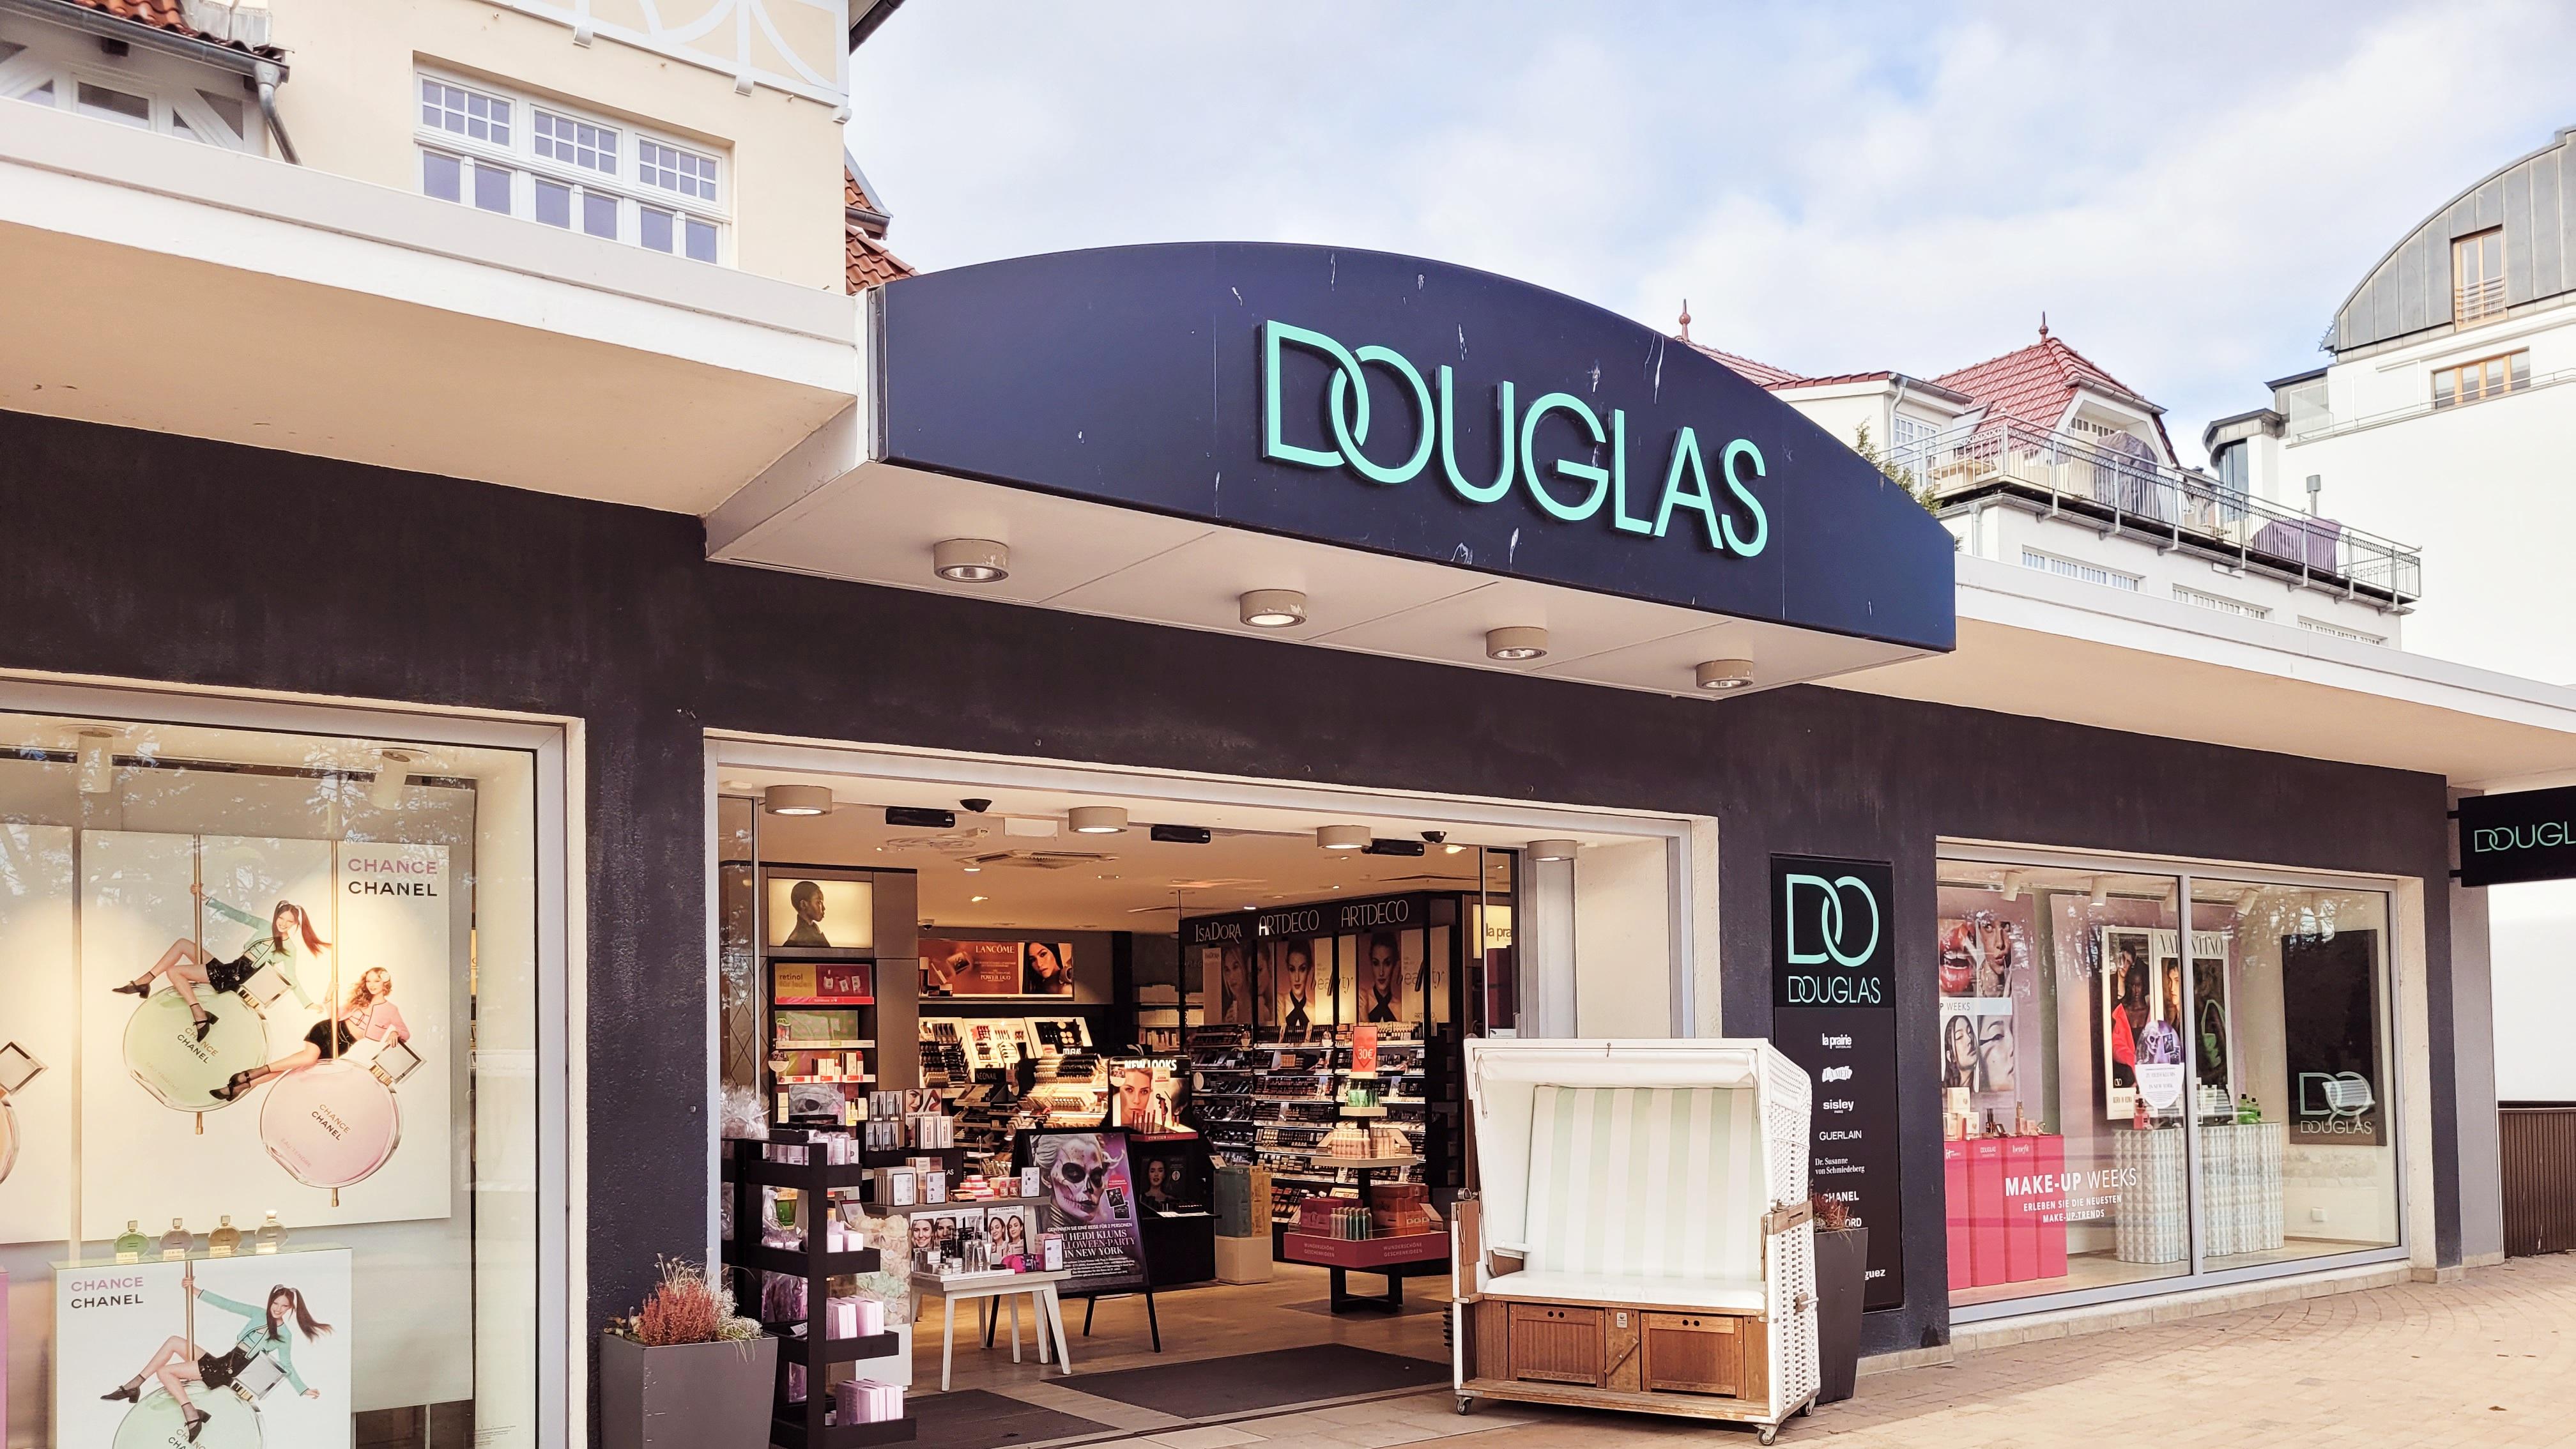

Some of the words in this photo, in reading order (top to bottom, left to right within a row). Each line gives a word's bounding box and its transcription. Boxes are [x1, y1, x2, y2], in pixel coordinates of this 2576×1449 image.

[1263, 319, 1768, 558] DOUGLAS
[2474, 821, 2576, 852] DOUGL
[348, 859, 438, 875] CHANCE
[348, 881, 438, 897] CHANEL
[1342, 900, 1408, 928] ARTDECO
[1786, 873, 1879, 967] DO
[1259, 910, 1319, 936] ARTDECO
[1485, 923, 1495, 937] la
[976, 944, 1015, 954] LANCÔME
[2159, 934, 2223, 956] VALNTINO
[1788, 976, 1881, 1004] DOUGLAS
[1946, 1002, 1971, 1011] WEEKS
[185, 1027, 218, 1057] CHNCE
[1821, 1032, 1829, 1046] la
[1829, 1034, 1852, 1049] prairie
[177, 1034, 209, 1064] CHANEL
[1358, 1048, 1374, 1059] 30€
[1124, 1060, 1146, 1069] NEW
[1823, 1099, 1854, 1112] sisley
[311, 1111, 341, 1141] CHANEL
[319, 1104, 351, 1133] CHANCE
[2301, 1120, 2372, 1134] DOUGLAS
[1819, 1130, 1862, 1141] GUERLAIN
[1815, 1158, 1824, 1166] Dr.
[1825, 1157, 1848, 1165] Susanne
[1826, 1165, 1865, 1174] Schmiedeberg
[2005, 1172, 2082, 1197] MAKE-UP
[2087, 1167, 2137, 1190] WEEKS
[2023, 1200, 2056, 1212] ERLEBEN
[2058, 1199, 2069, 1209] SIE
[2072, 1198, 2084, 1208] DIE
[2086, 1194, 2122, 1206] NEUESTEN
[1845, 1217, 1862, 1227] ORD
[2043, 1209, 2105, 1223] MAKE-UP-TRENDS
[1070, 1231, 1095, 1241] HEIDI
[1096, 1229, 1127, 1239] KLUMS
[1062, 1237, 1135, 1250] LLOWEEN-PARTY
[1064, 1250, 1075, 1258] IN
[1076, 1248, 1097, 1257] NEW
[1099, 1246, 1124, 1255] YORK
[71, 1276, 144, 1292] CHANCE
[71, 1294, 144, 1309] CHANEL
